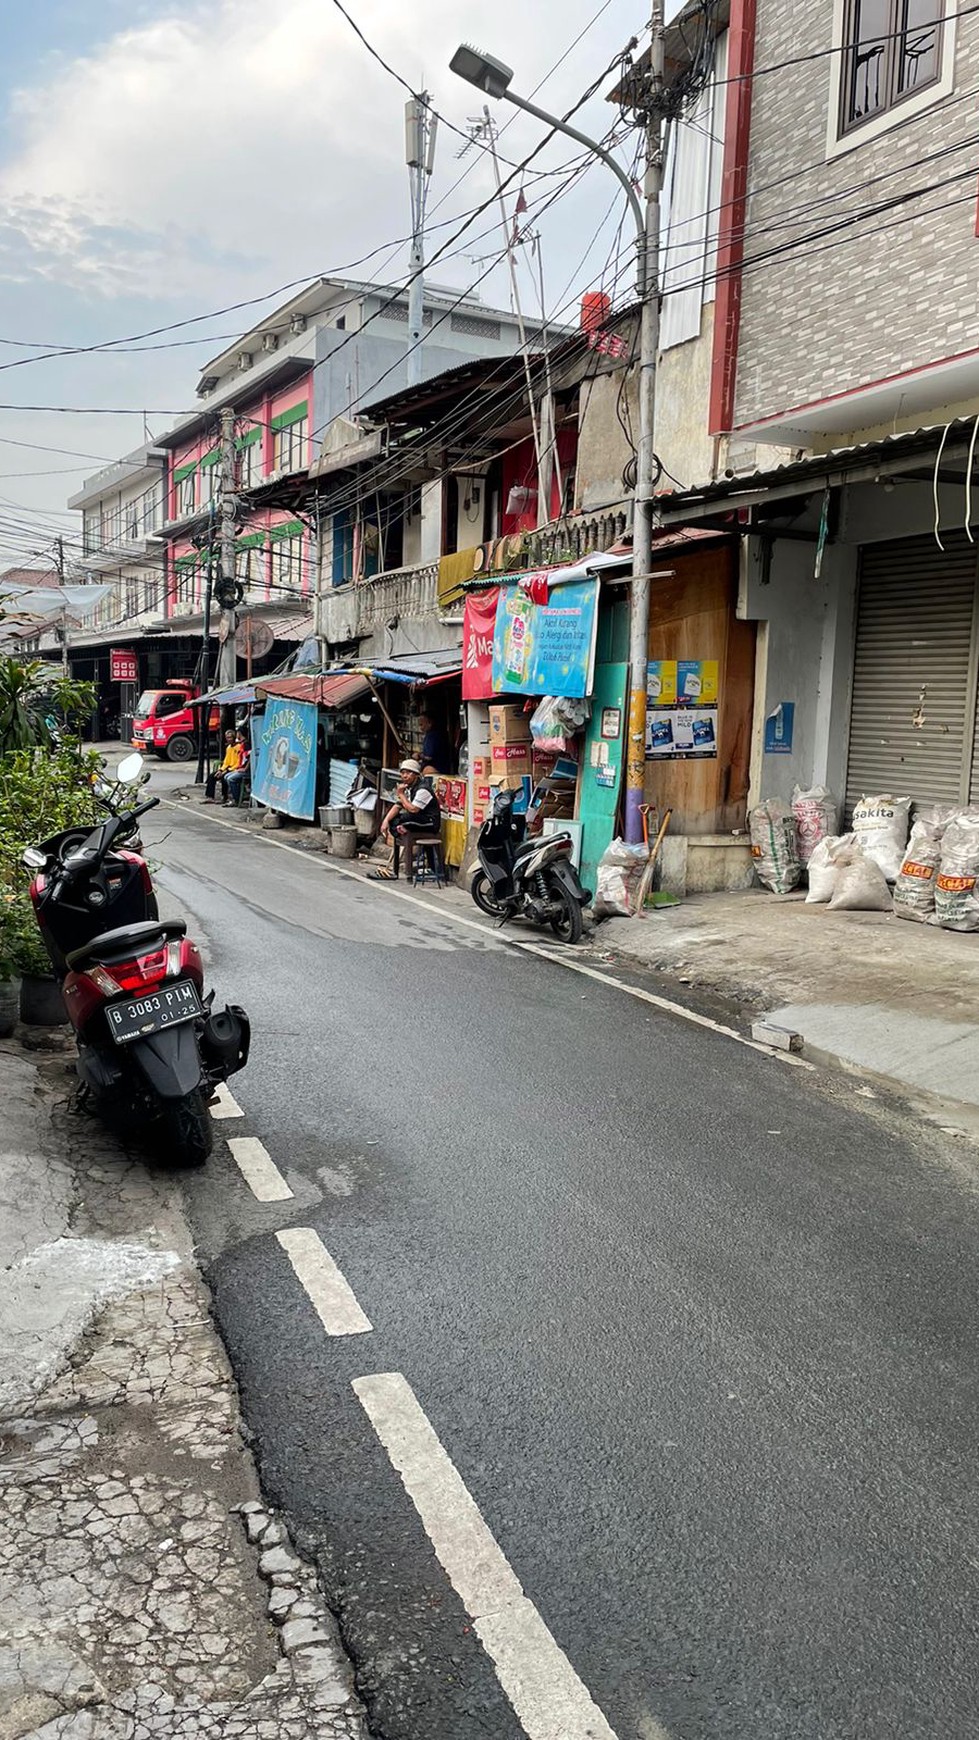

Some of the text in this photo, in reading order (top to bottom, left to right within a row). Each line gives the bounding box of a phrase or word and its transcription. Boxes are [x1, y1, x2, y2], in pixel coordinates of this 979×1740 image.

[854, 808, 894, 820] sakita
[112, 986, 193, 1024] B 3083 PIM
